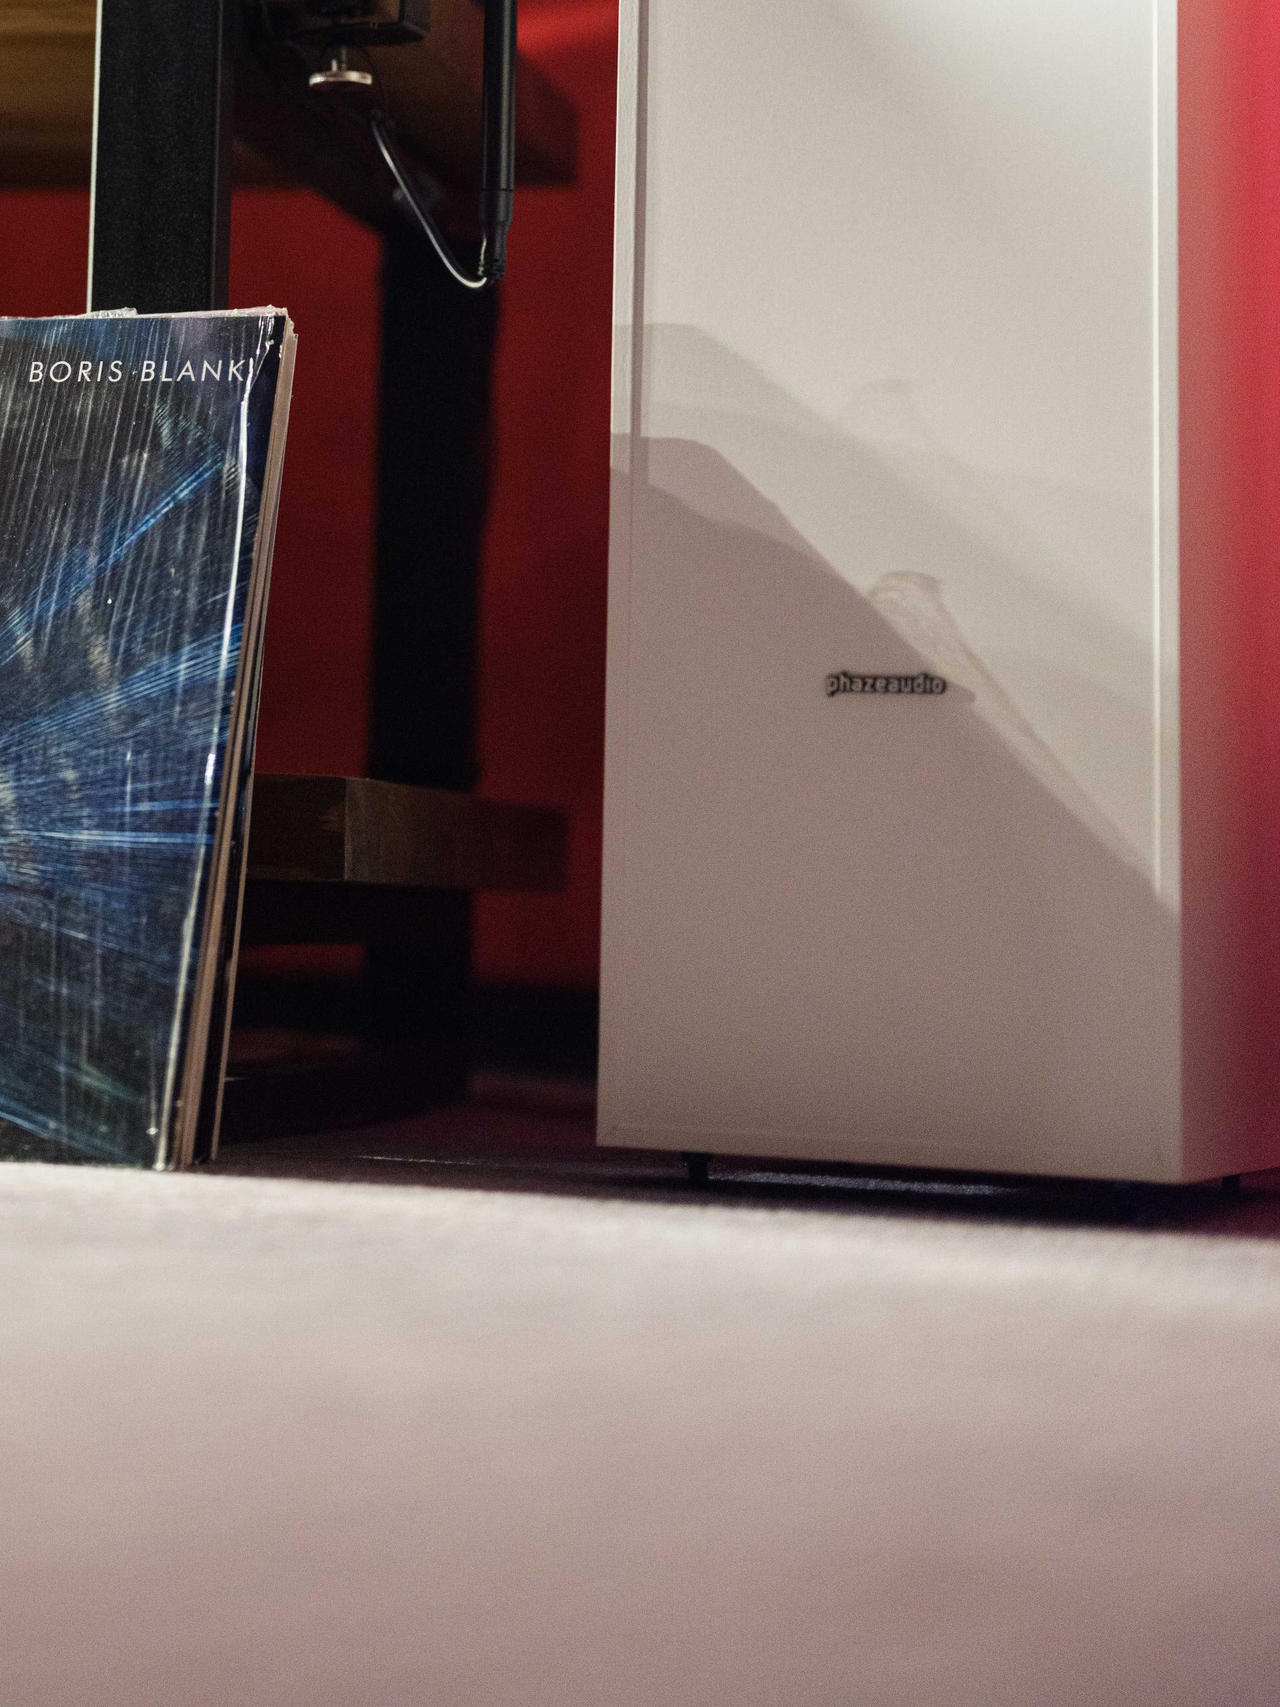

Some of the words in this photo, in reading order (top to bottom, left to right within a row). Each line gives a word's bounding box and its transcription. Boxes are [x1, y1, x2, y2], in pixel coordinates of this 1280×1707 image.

[29, 360, 123, 384] BORIS
[140, 359, 246, 383] BLANK
[826, 669, 947, 697] phazeaudio
